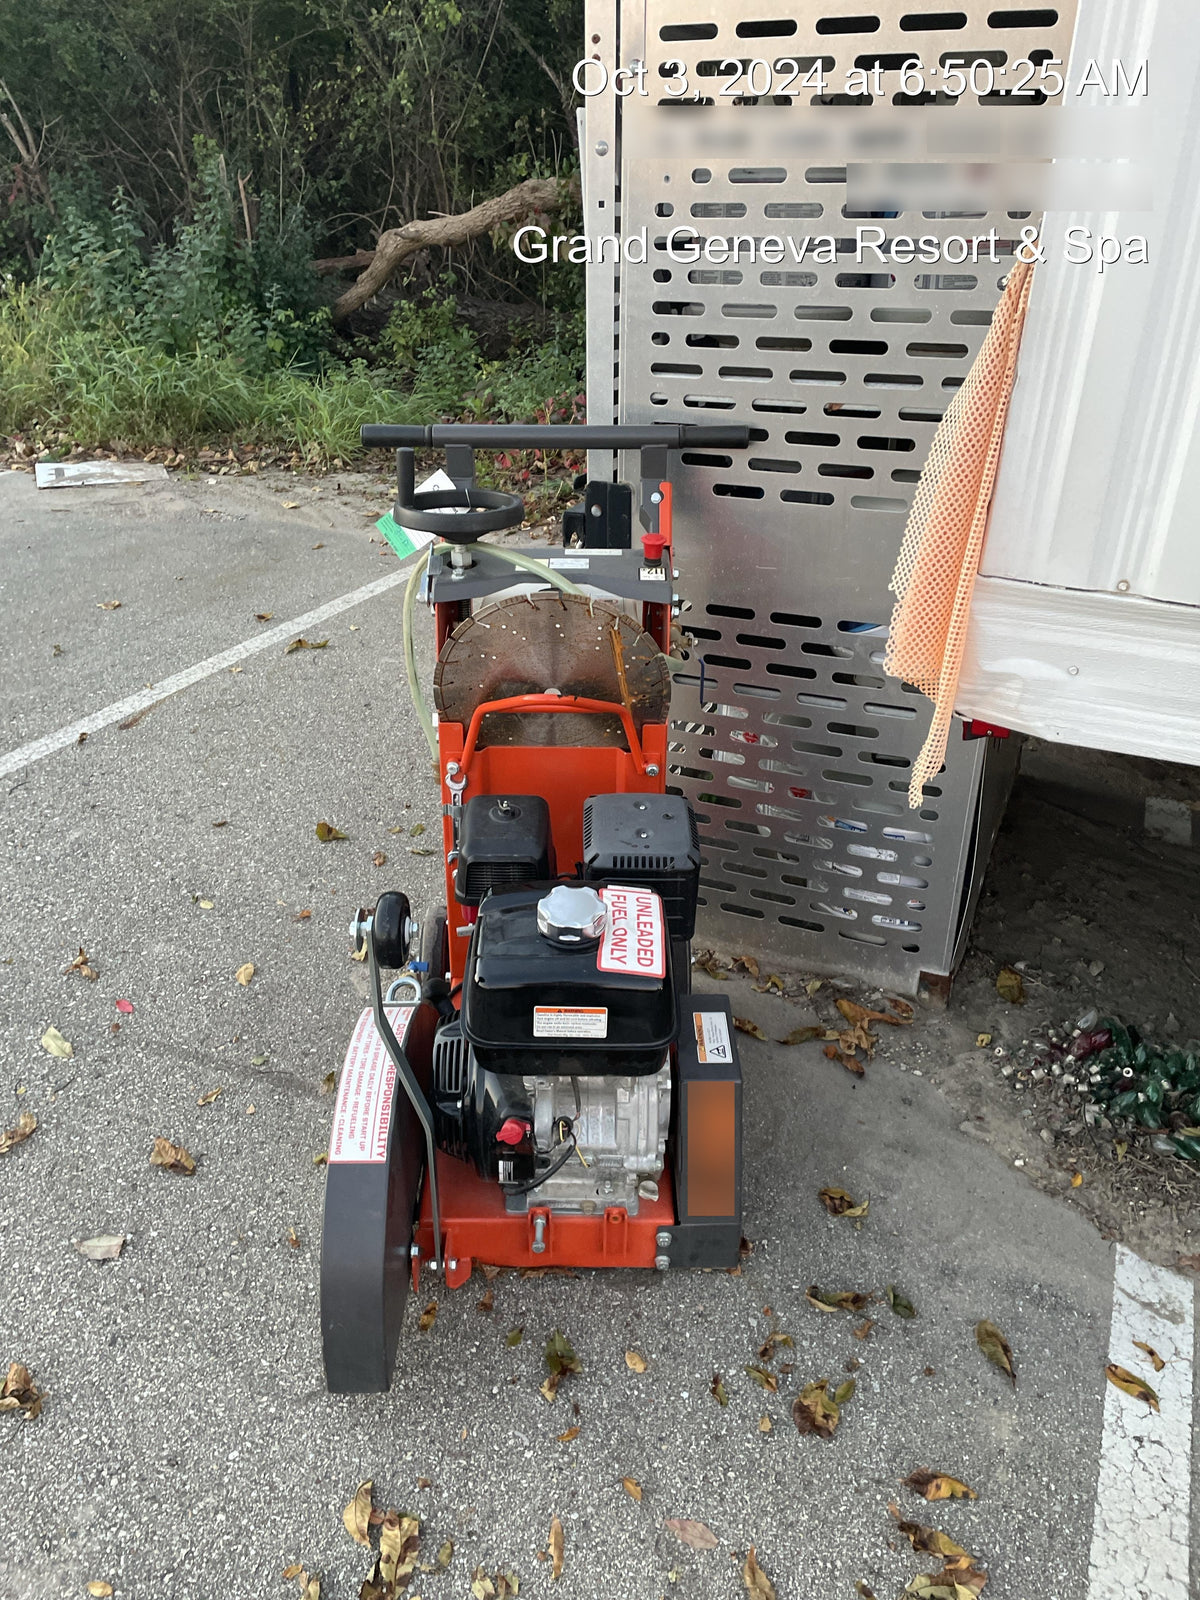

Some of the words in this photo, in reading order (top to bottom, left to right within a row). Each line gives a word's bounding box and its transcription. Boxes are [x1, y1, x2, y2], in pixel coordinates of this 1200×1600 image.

[610, 894, 627, 925] FUEL
[610, 928, 628, 965] ONLY
[636, 896, 654, 967] UNLEADED
[348, 1046, 359, 1067] BATTERY
[340, 1069, 354, 1113] MAINTENANCE
[355, 1071, 365, 1096] DAMAGE
[367, 1072, 376, 1089] DAILY
[363, 1090, 373, 1115] BEFORE
[377, 1065, 396, 1158] RESPONSIBILITY
[348, 1101, 360, 1139] REFUELING
[360, 1117, 369, 1139] START
[335, 1119, 346, 1155] CLEANING
[359, 1141, 366, 1152] UP
